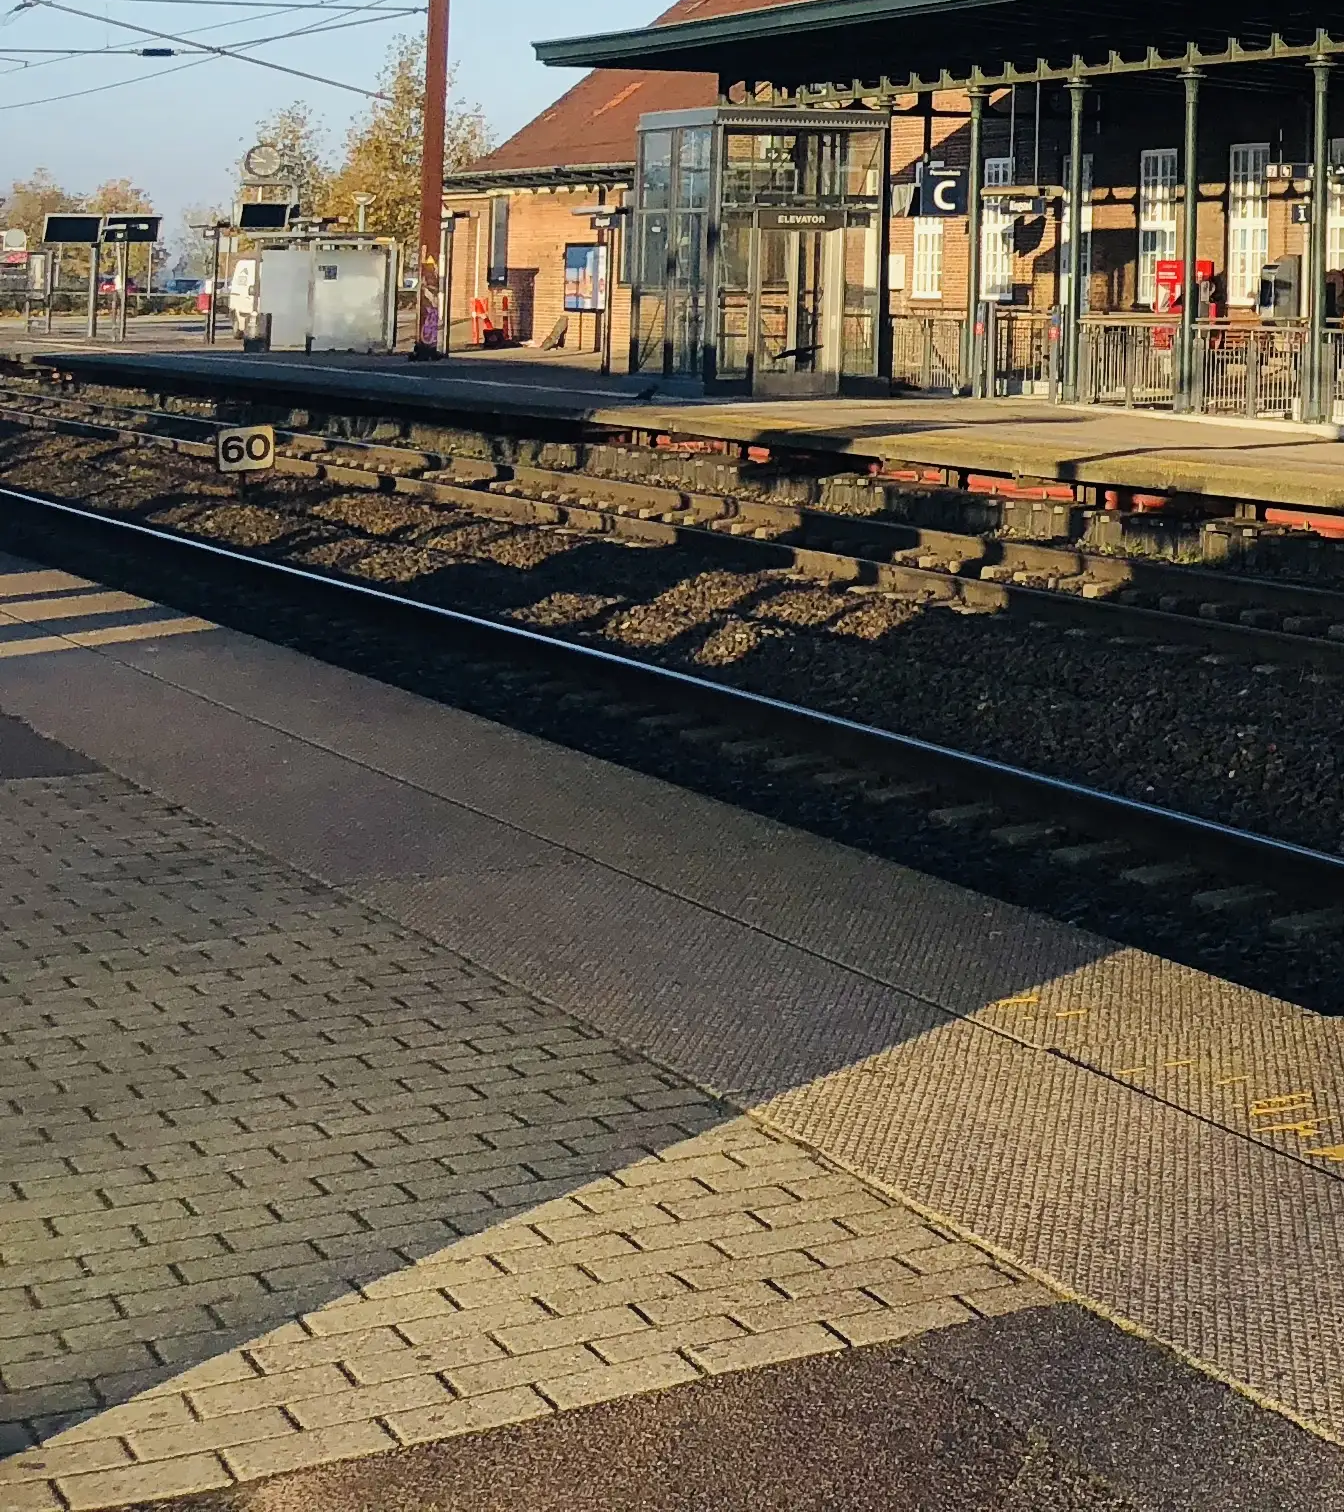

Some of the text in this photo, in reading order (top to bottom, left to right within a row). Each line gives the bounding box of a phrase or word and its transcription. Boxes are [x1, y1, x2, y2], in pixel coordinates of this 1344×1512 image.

[933, 179, 957, 211] C
[777, 214, 826, 224] ELEVATOR
[221, 433, 271, 464] 60
